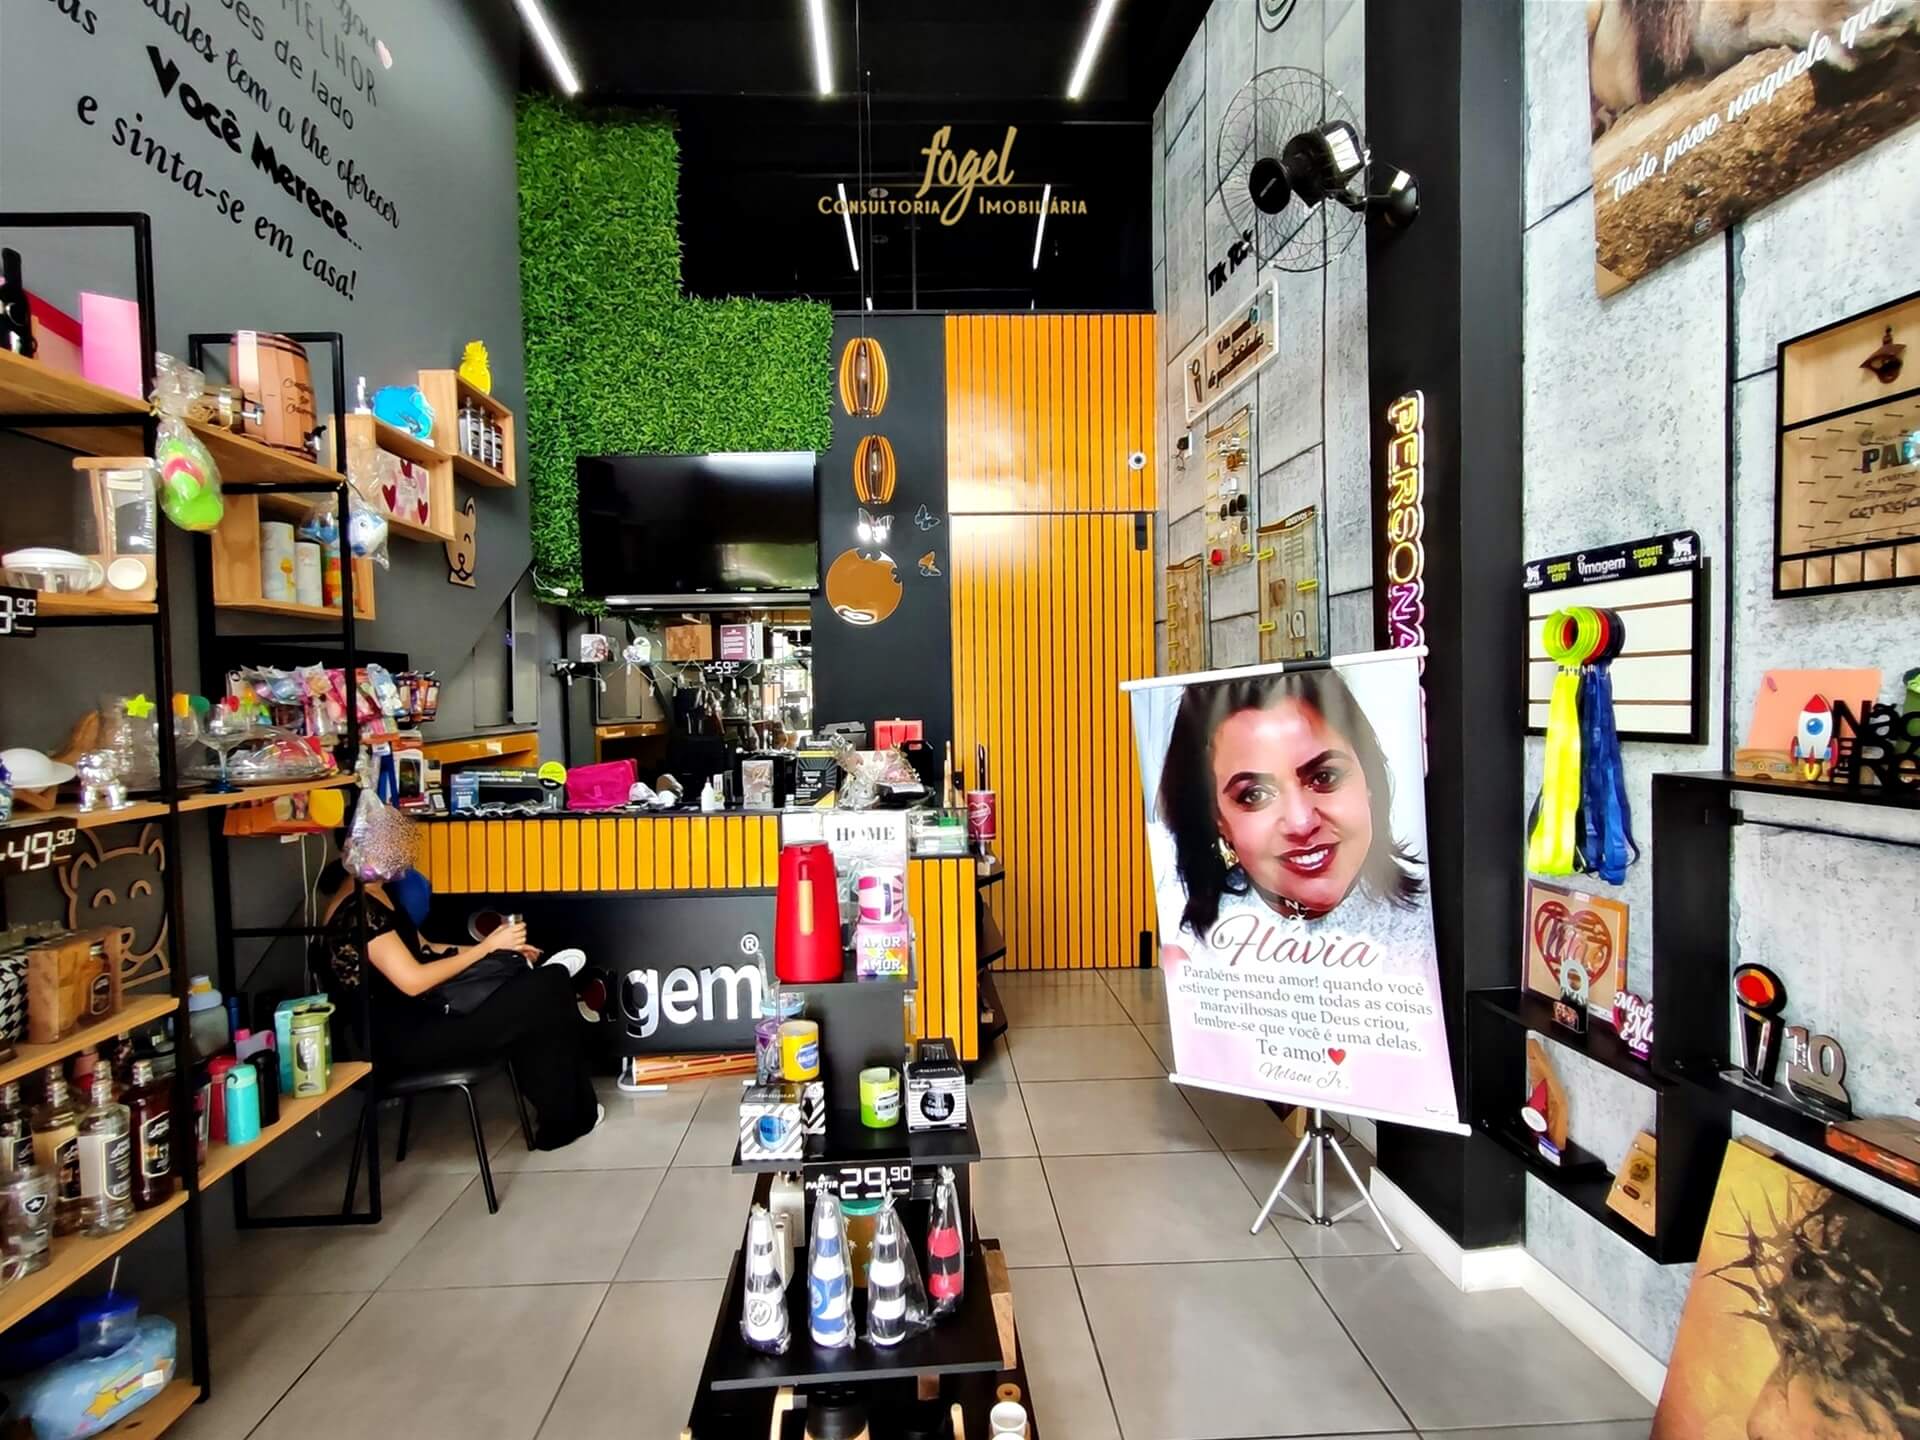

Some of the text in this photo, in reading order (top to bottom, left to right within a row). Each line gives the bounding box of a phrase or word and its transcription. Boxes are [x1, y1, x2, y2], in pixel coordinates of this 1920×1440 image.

[221, 0, 354, 130] es de lado
[143, 0, 218, 63] ades
[225, 48, 273, 112] tem
[279, 105, 295, 134] a
[300, 116, 333, 166] lhe
[146, 44, 243, 155] Você
[1663, 112, 1722, 175] posso
[1727, 29, 1832, 121] naquele
[915, 125, 1018, 227] fogel
[77, 94, 358, 302] e sinta-se em casa!
[836, 826, 896, 842] HOME
[1183, 964, 1425, 997] Parabéns meu amor! quando você
[1178, 981, 1434, 1016] estiver pensando em todas as coisas
[1193, 1011, 1422, 1053] lembre-se que você é uma delas.
[1199, 1000, 1410, 1033] maravilhosas que Deus criou,
[1255, 1038, 1327, 1065] Te amo!
[1258, 1061, 1349, 1090] Nelson Jr.
[804, 1180, 839, 1191] PARTIR
[840, 1165, 912, 1200] 29,90
